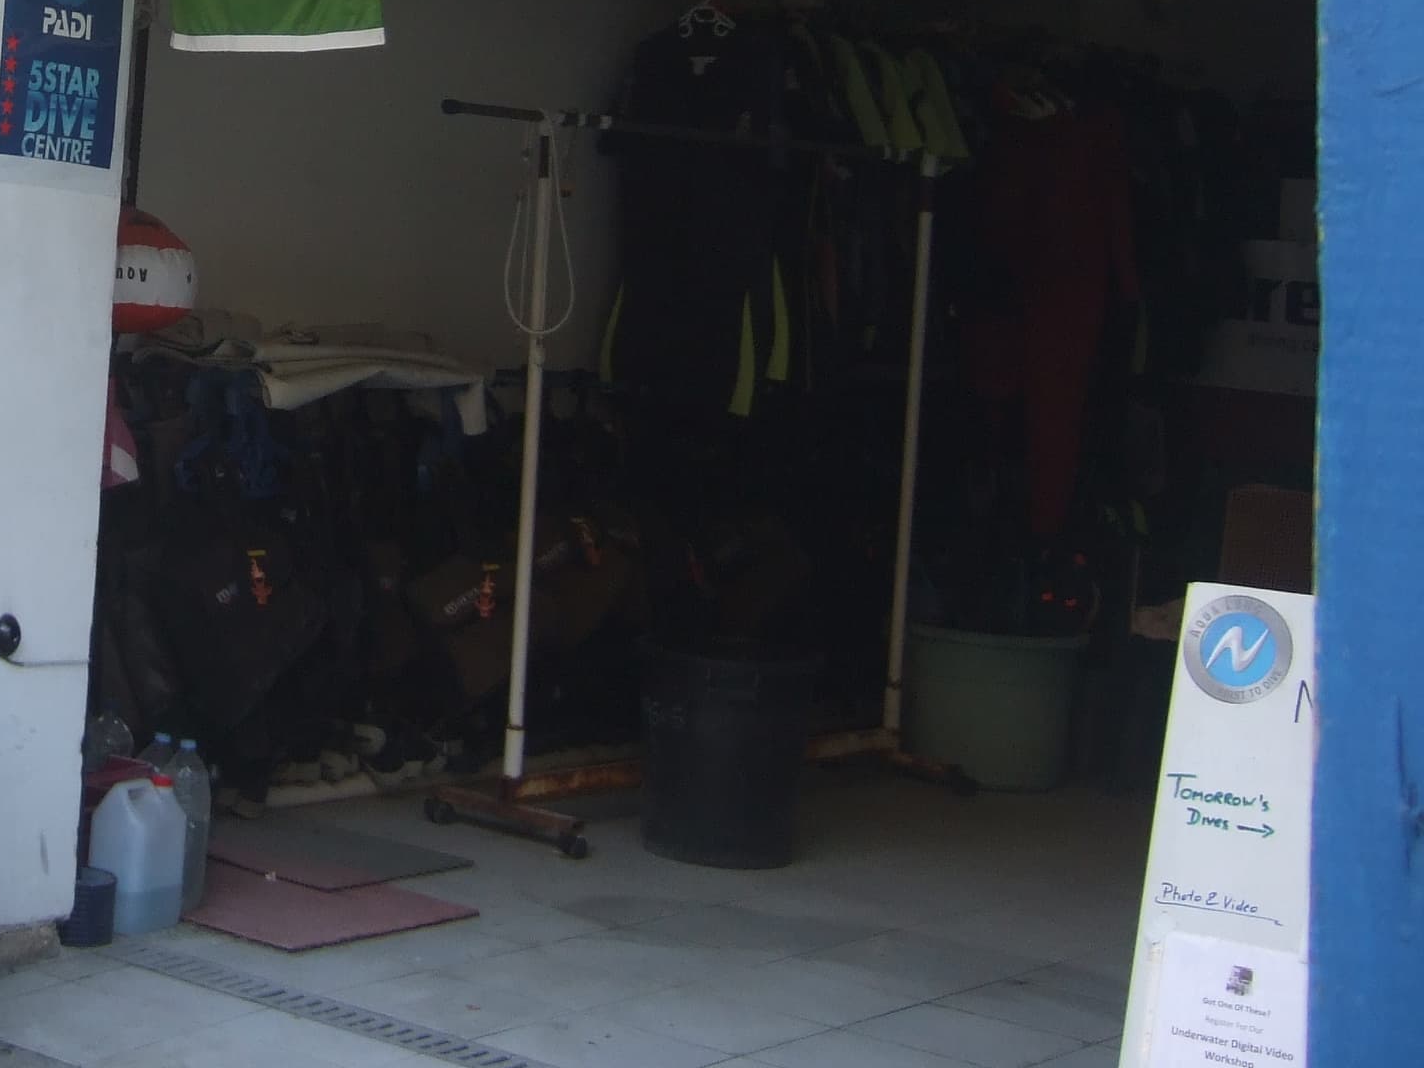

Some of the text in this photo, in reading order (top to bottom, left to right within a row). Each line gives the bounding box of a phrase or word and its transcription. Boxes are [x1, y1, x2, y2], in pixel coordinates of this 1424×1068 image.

[42, 6, 93, 41] PADI
[23, 91, 98, 141] DIVE
[21, 132, 94, 165] CENTRE
[1161, 882, 1203, 903] Photo
[1224, 895, 1259, 913] Video
[1170, 1026, 1295, 1062] Underwater Digital Video
[1203, 1050, 1255, 1068] Workshop
